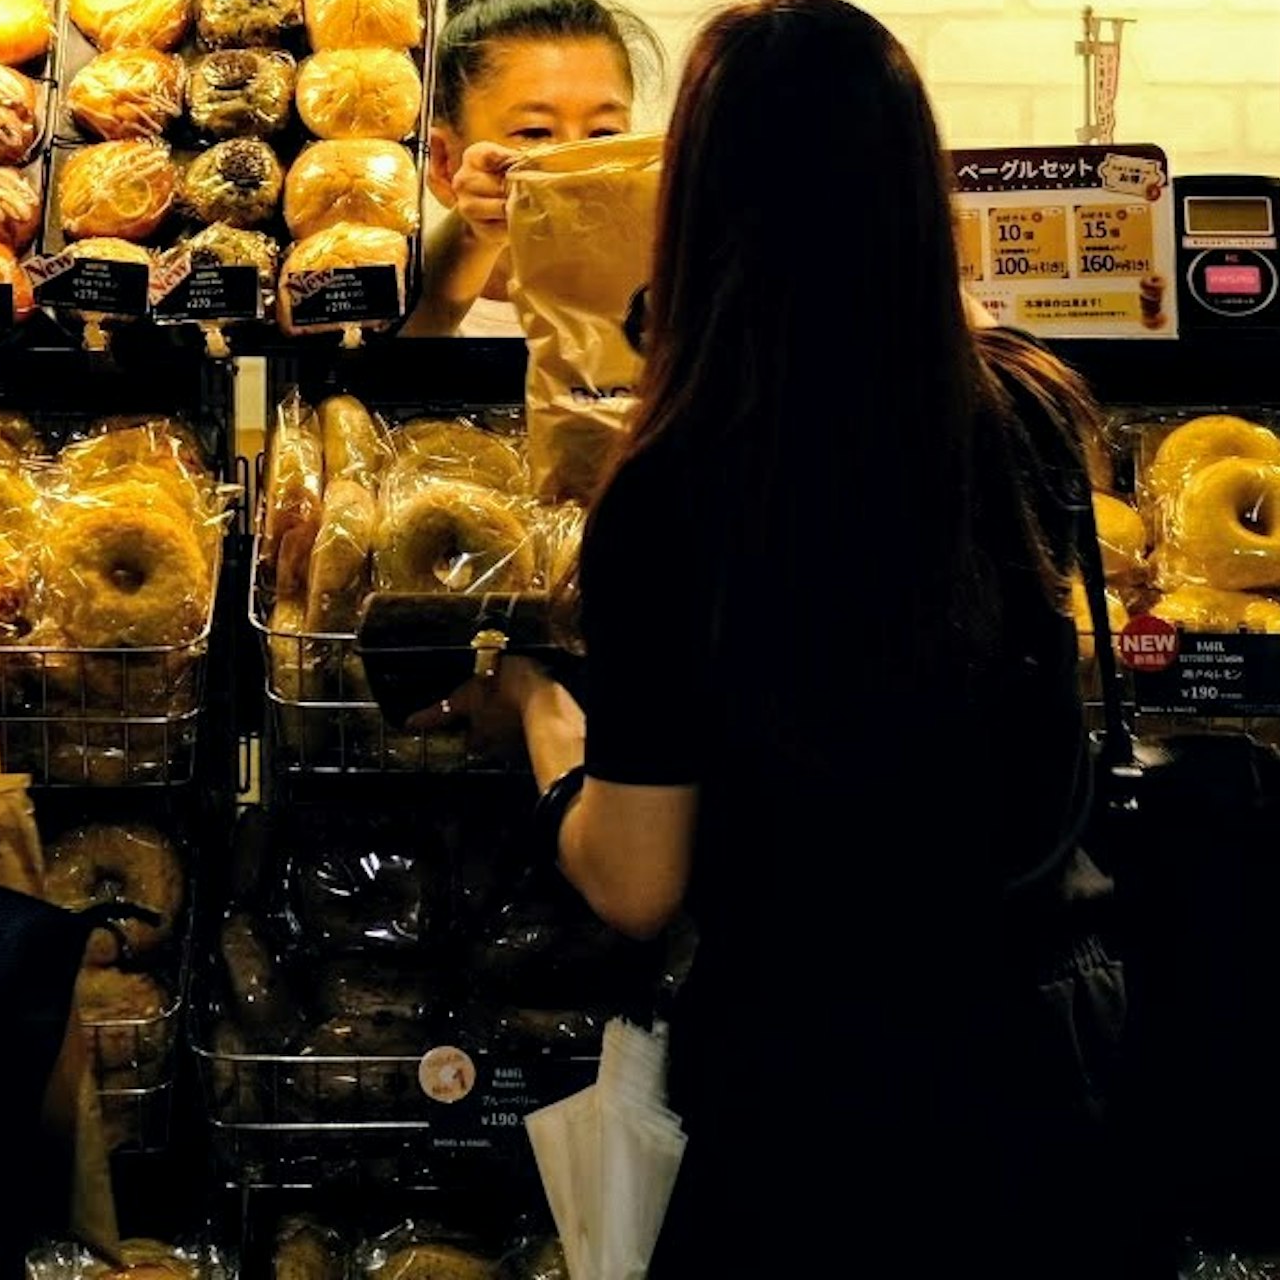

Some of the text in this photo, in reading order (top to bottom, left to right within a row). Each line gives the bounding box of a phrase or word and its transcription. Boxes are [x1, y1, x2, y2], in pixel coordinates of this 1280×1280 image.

[958, 157, 1094, 181] ベーグルセット
[1123, 634, 1176, 652] NEW
[1181, 686, 1218, 700] ¥190
[481, 1112, 518, 1126] ¥190
